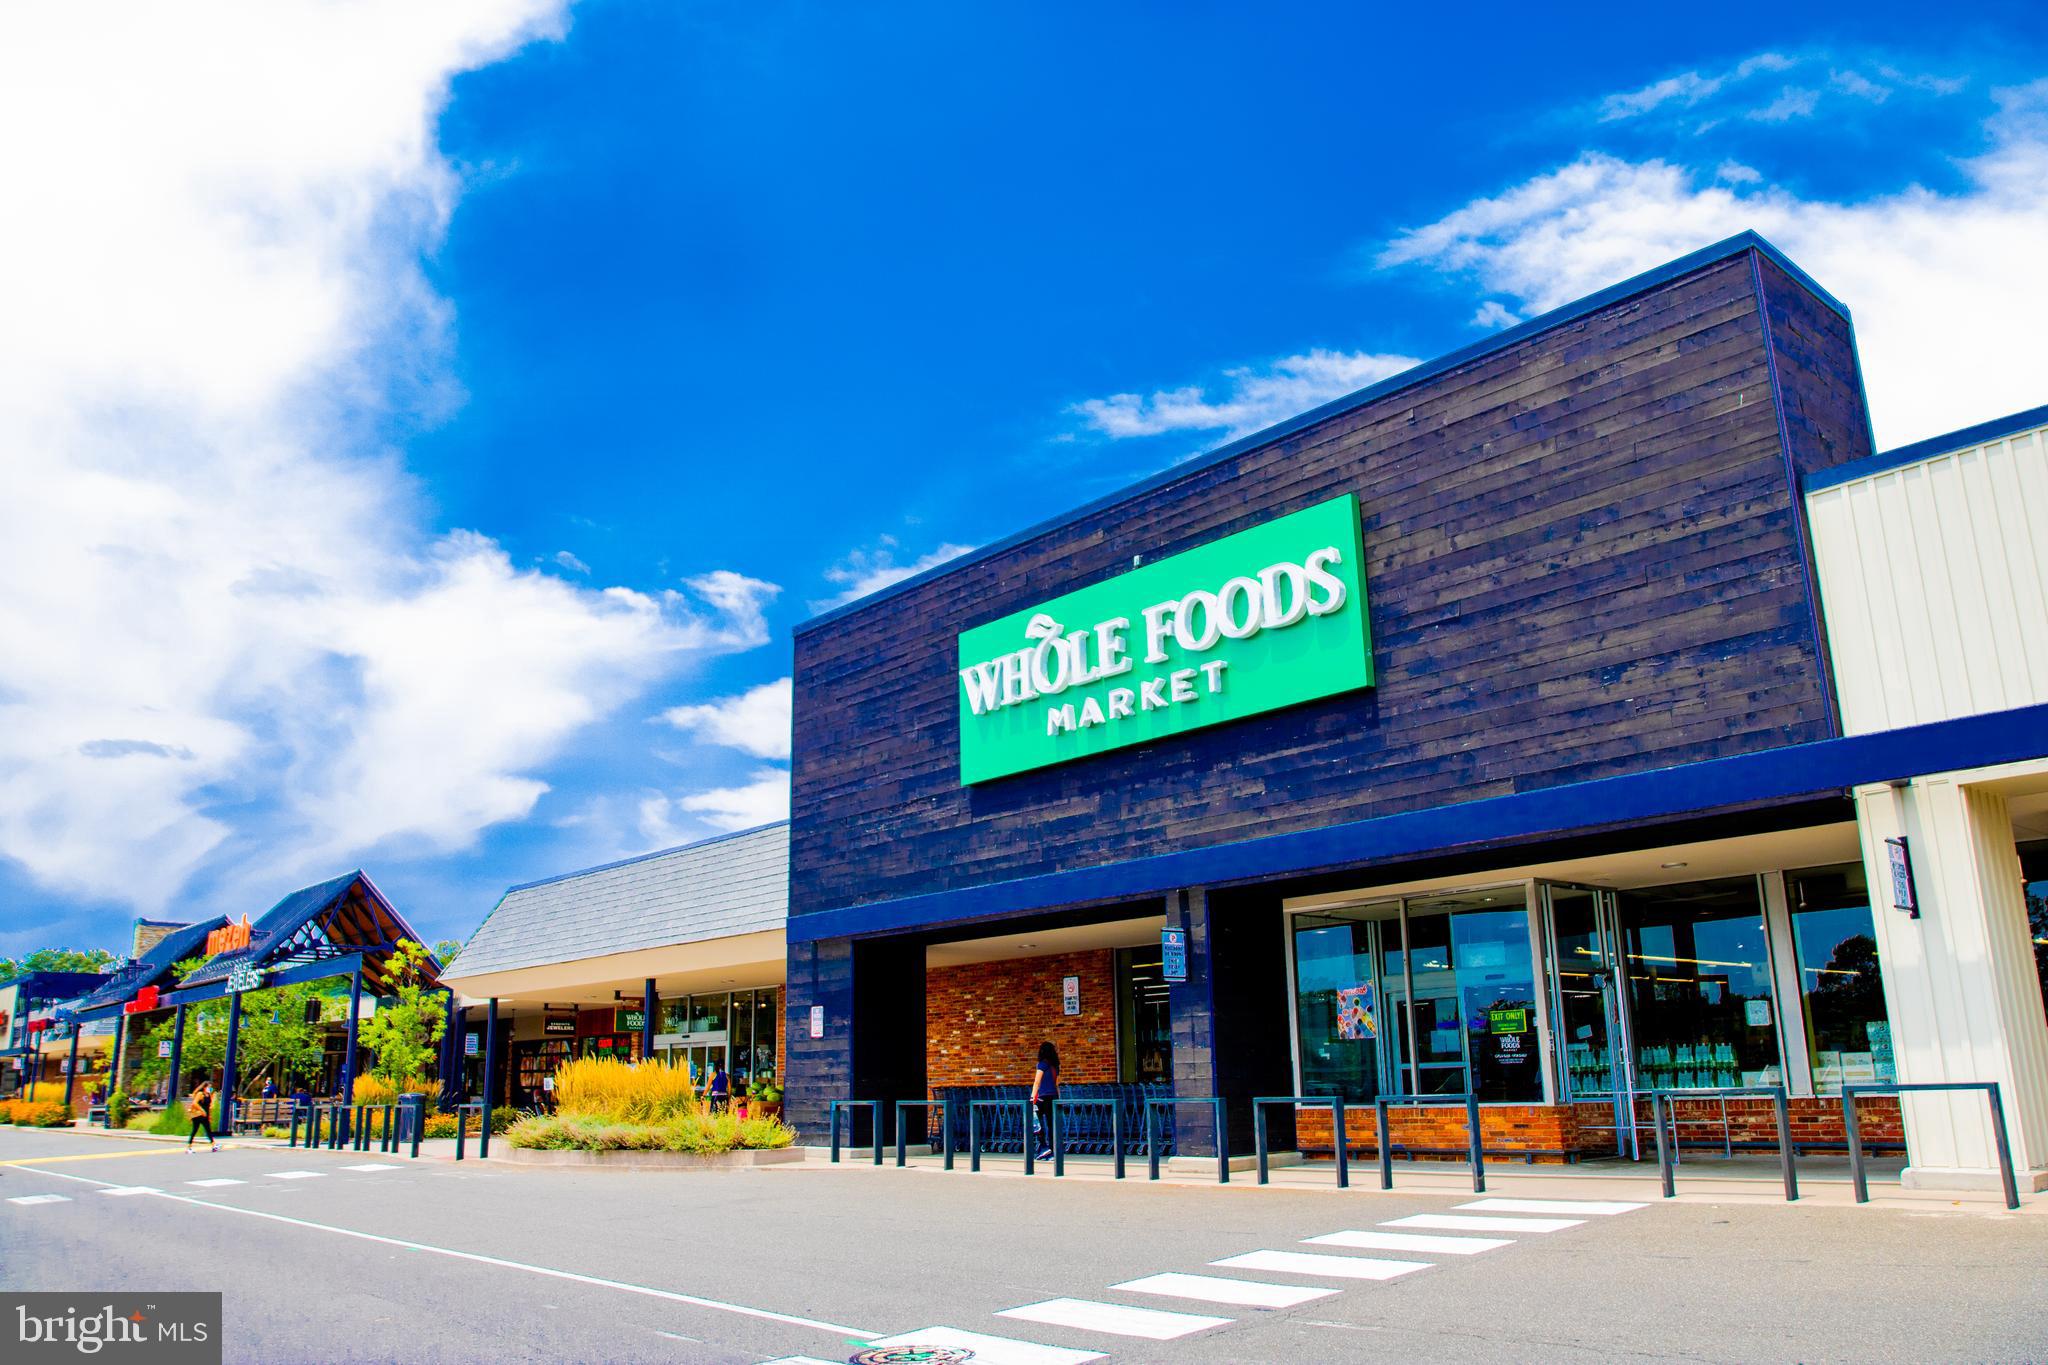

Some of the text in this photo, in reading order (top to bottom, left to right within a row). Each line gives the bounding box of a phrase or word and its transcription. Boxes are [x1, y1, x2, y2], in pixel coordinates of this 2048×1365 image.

[960, 546, 1348, 716] WHOLE FOODS
[1046, 660, 1229, 736] MARKET
[206, 912, 251, 956] mezeh
[1491, 1011, 1524, 1021] EXIT ONLY!
[1500, 1034, 1521, 1043] WHOLE
